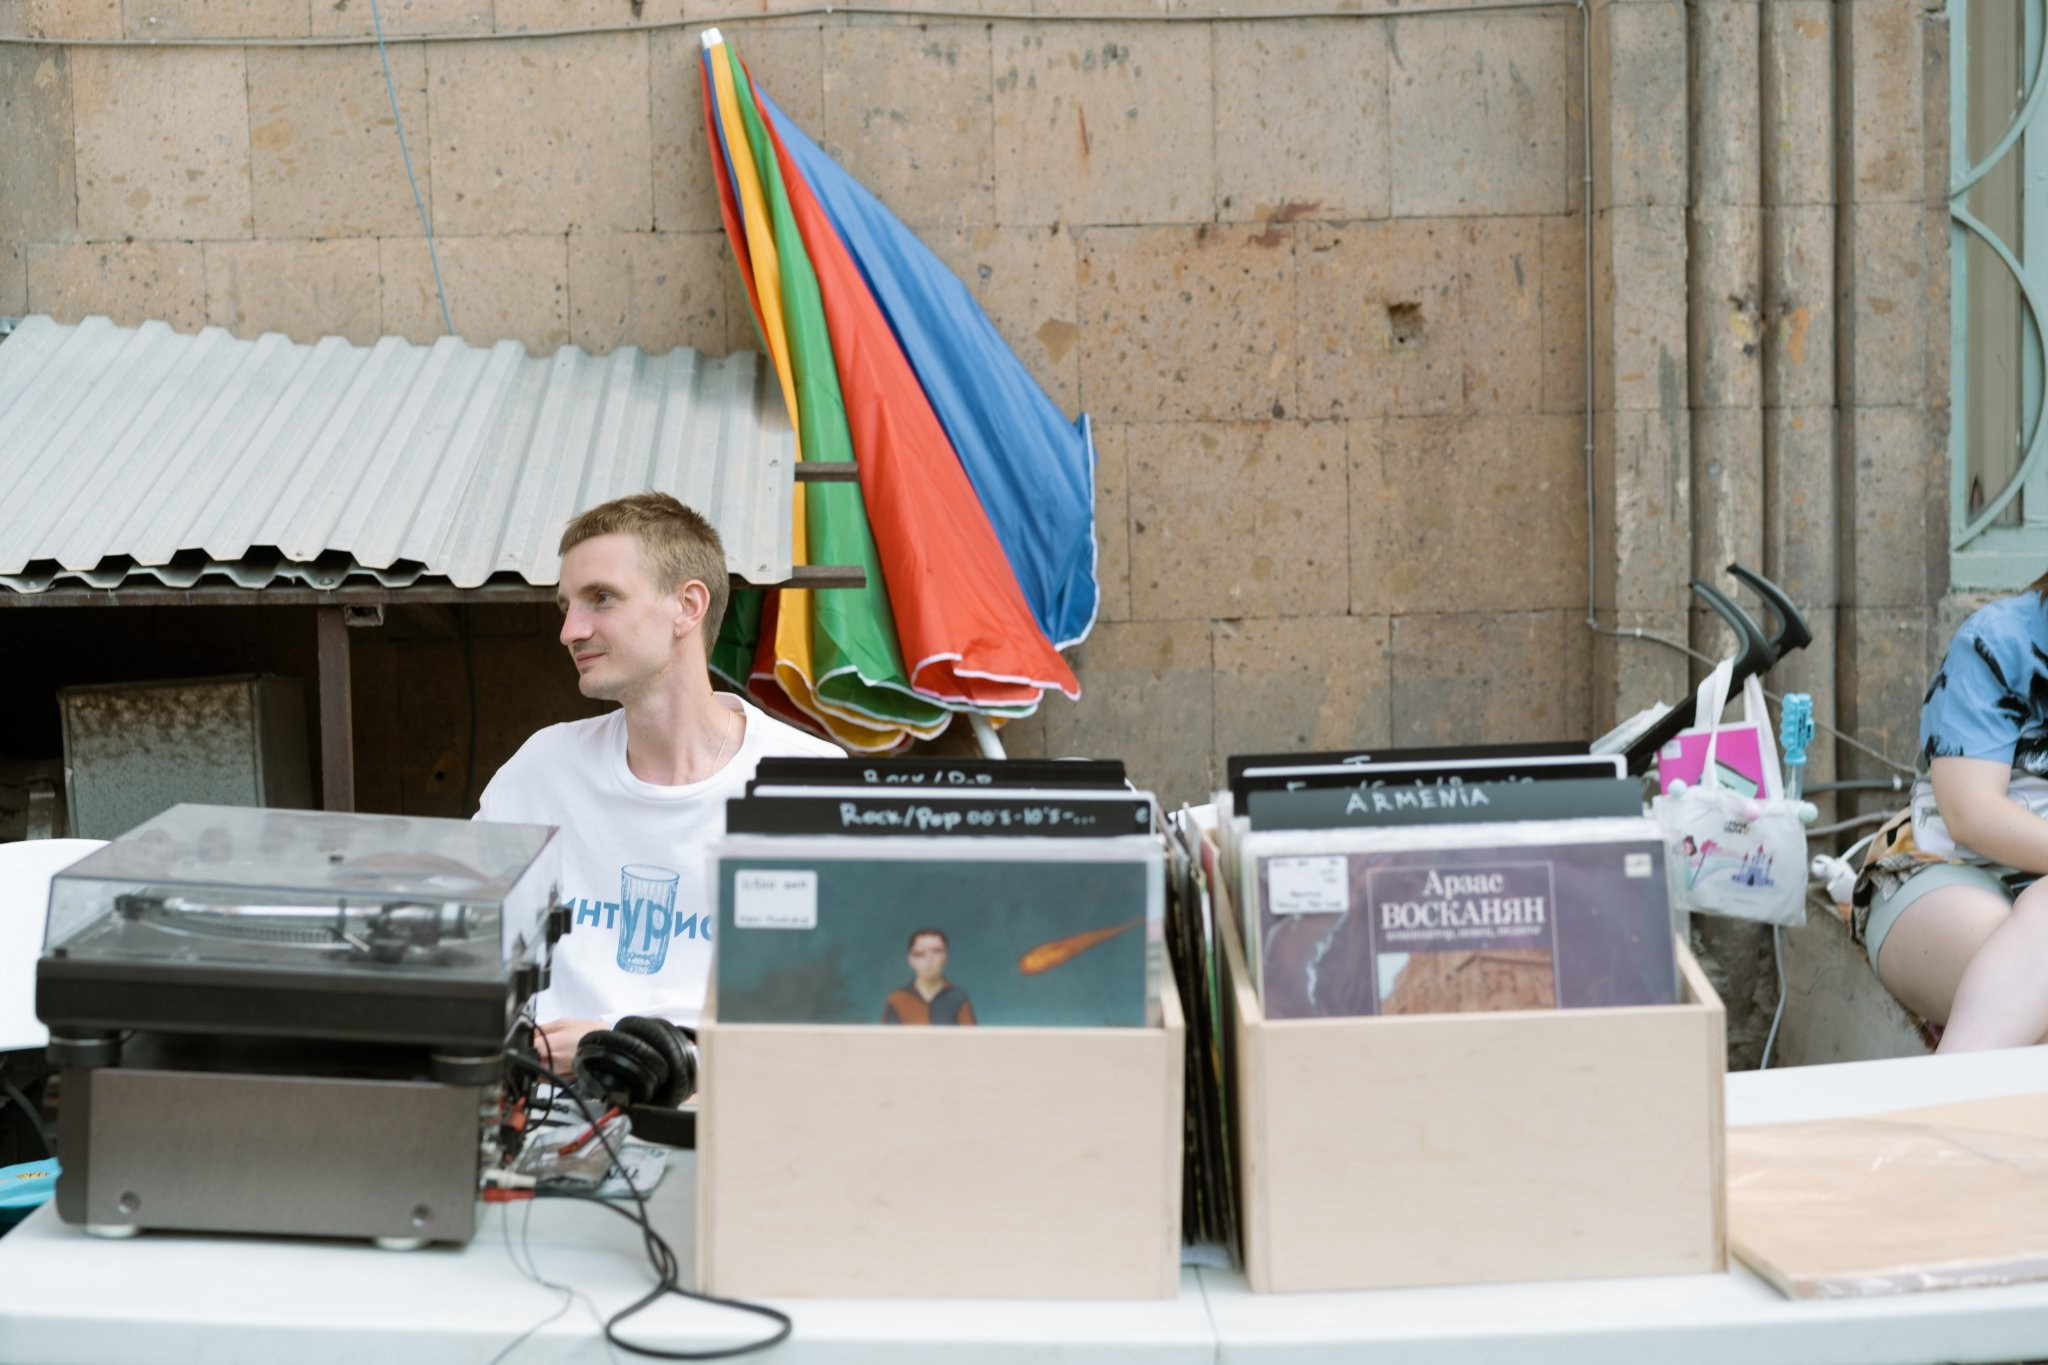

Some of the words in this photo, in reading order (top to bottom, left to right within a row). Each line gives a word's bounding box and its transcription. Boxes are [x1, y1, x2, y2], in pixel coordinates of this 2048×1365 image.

[839, 802, 961, 831] Rock/Pop
[1423, 869, 1505, 900] Арзас
[566, 897, 713, 951] нтурис
[1381, 896, 1545, 929] ВОСКАНЯН
